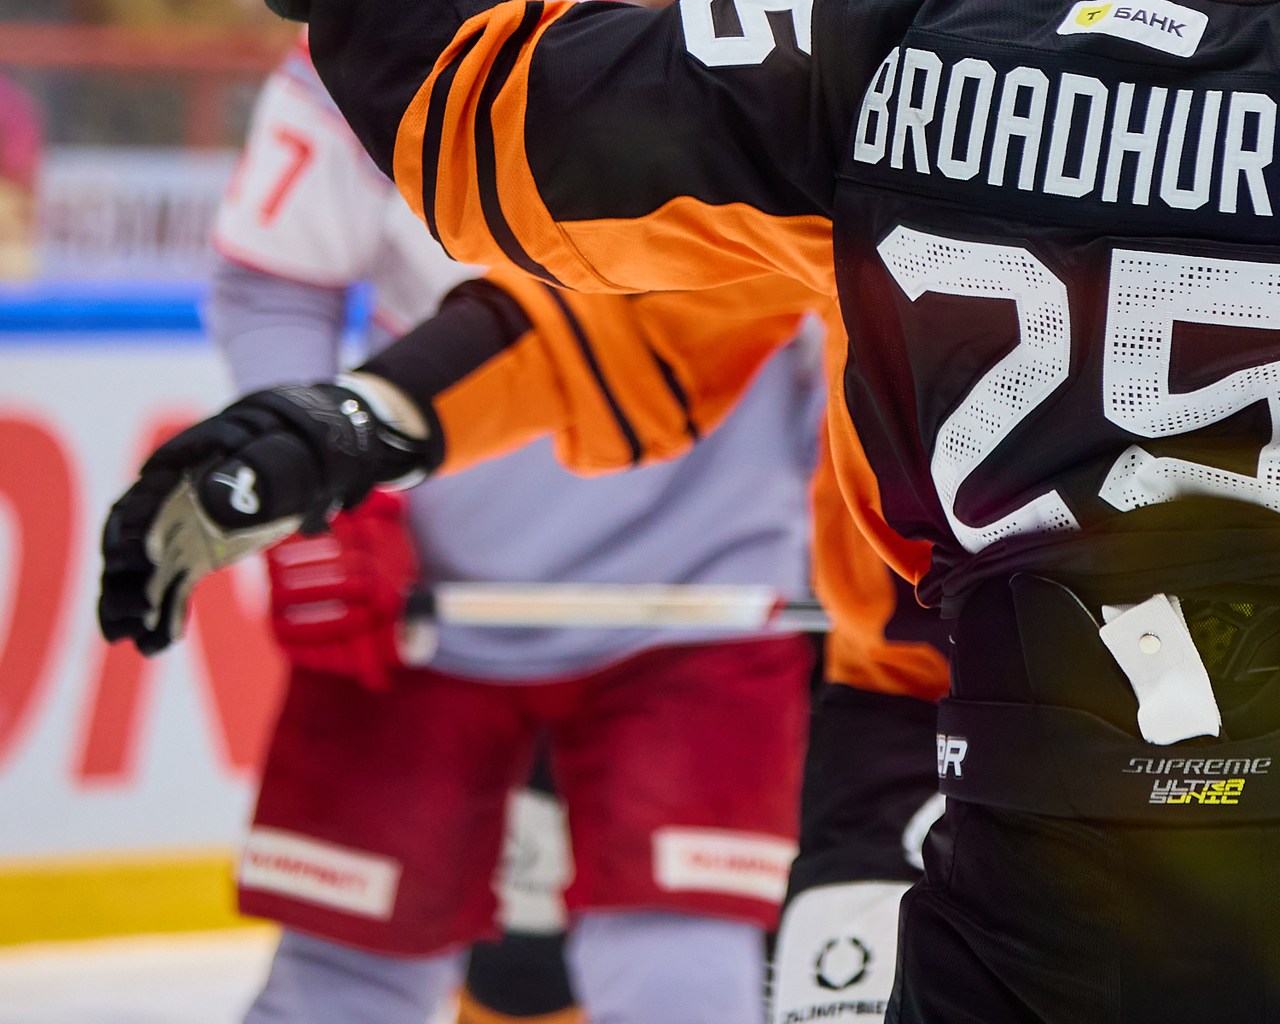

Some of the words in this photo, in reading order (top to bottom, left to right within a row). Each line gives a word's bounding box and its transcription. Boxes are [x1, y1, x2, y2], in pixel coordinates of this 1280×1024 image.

[1113, 7, 1188, 38] БАНК
[1152, 778, 1246, 792] ULTRA
[1148, 790, 1242, 805] SONIC
